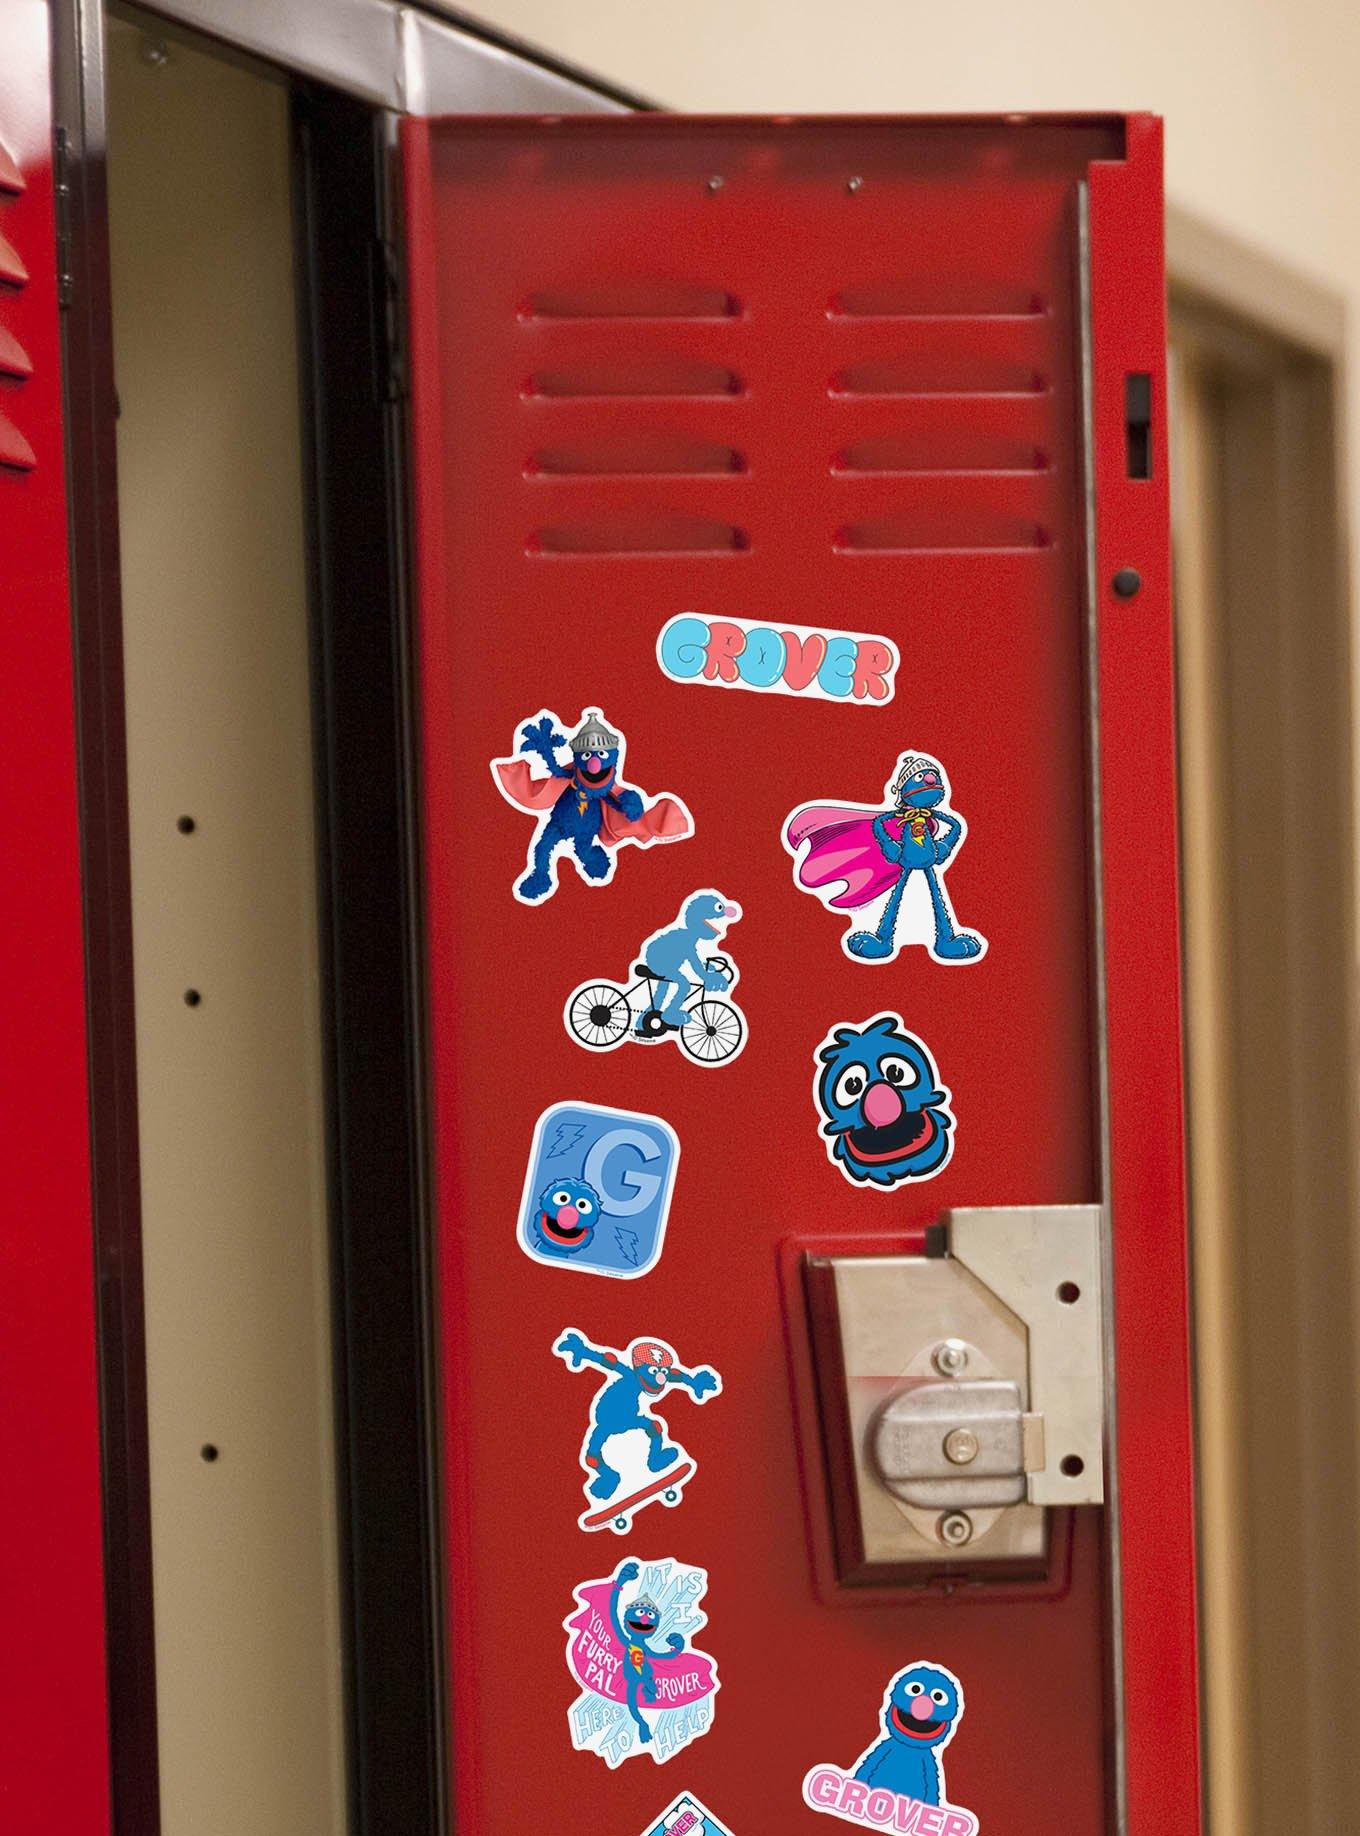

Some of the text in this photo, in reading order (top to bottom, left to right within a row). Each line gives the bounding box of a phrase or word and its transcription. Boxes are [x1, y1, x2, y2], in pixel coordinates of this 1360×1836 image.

[661, 618, 894, 700] GROVER
[581, 1128, 662, 1218] G
[647, 1562, 703, 1595] IT IS
[588, 1609, 612, 1651] YOUR
[578, 1631, 623, 1674] FURRY
[585, 1661, 616, 1696] PAL
[655, 1672, 707, 1701] GROVER
[573, 1706, 624, 1744] HERE
[601, 1708, 710, 1763] TO HELP
[664, 1811, 698, 1836] VER
[810, 1771, 972, 1836] GROVER
